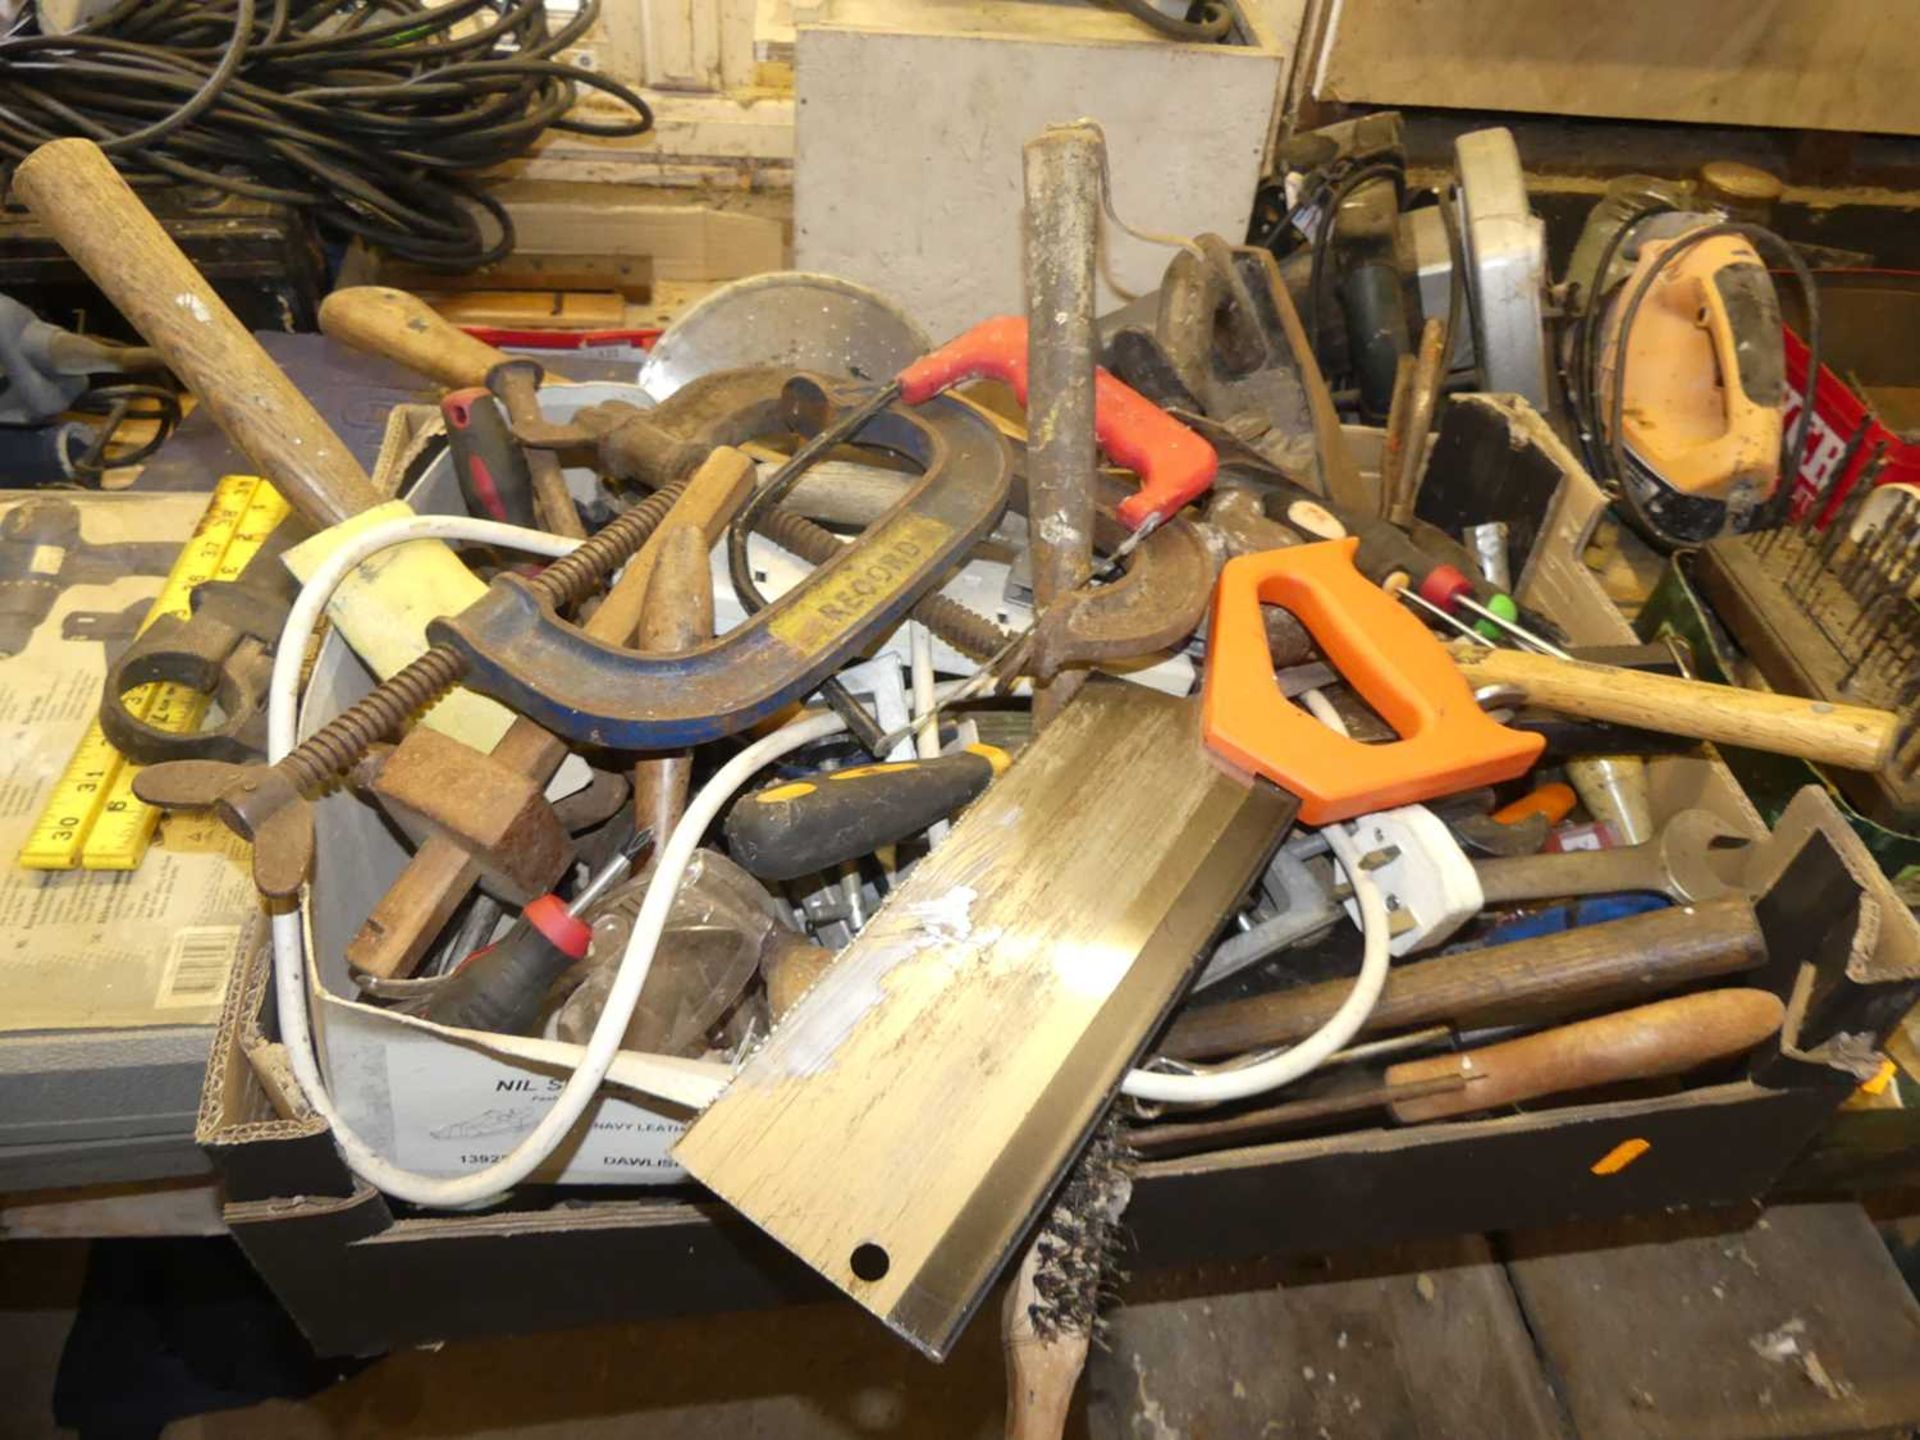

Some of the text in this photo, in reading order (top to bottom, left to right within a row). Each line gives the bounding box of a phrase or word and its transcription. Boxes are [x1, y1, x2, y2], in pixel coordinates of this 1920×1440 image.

[817, 541, 921, 623] RECORD
[77, 770, 104, 793] 31
[52, 816, 79, 841] 30
[496, 1079, 565, 1092] NIL S
